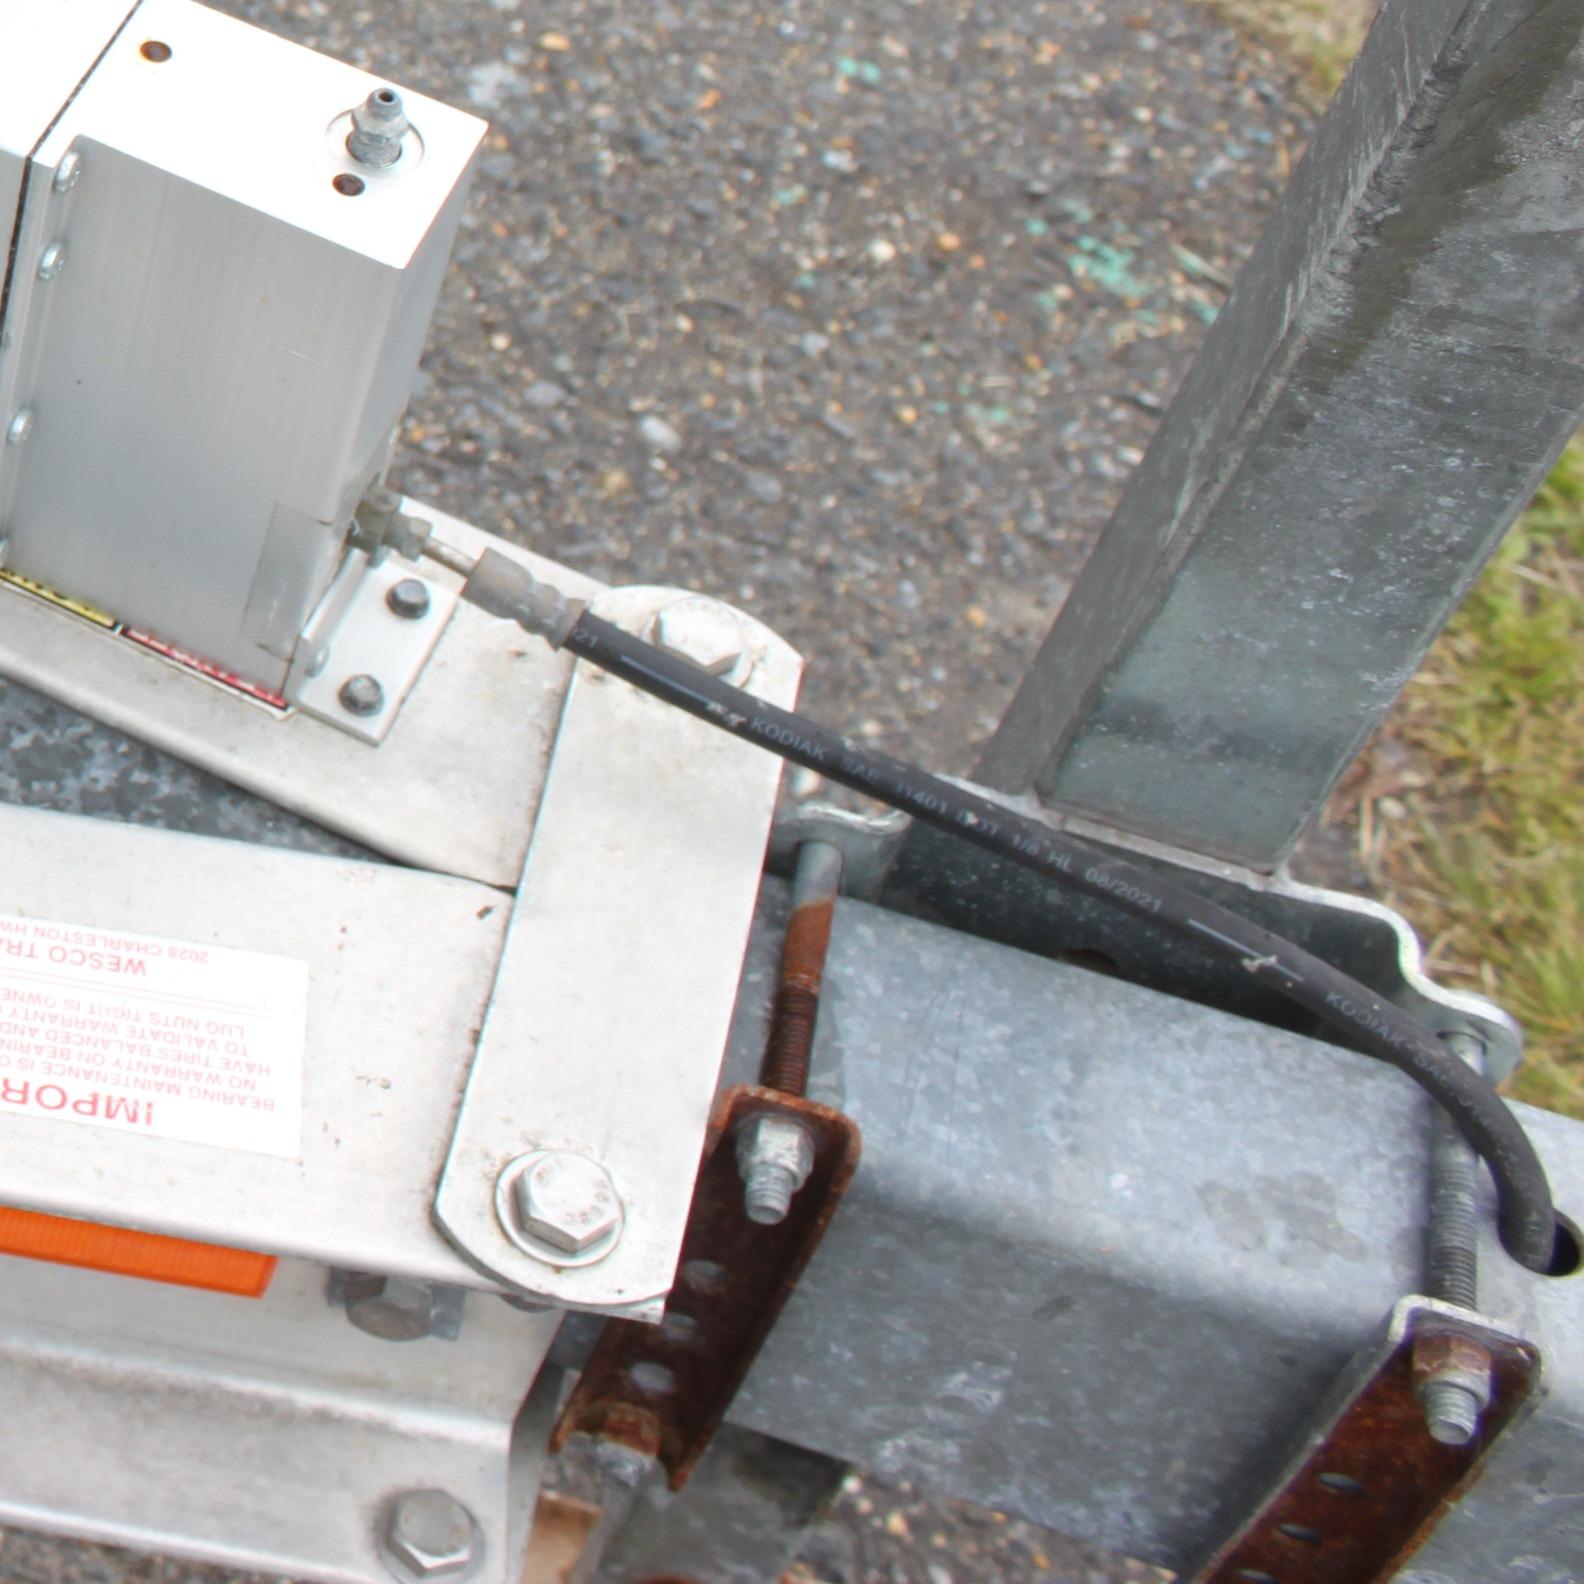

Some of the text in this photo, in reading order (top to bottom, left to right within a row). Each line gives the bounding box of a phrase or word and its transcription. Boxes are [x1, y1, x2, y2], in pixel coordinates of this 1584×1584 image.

[747, 717, 828, 762] KODIAK
[1012, 832, 1041, 857] 1/8
[1046, 850, 1072, 874] HL
[1085, 866, 1163, 913] 08/2021
[32, 924, 162, 957] CHARLESTON
[46, 943, 147, 977] WESCO
[63, 997, 81, 1012] IS
[86, 1000, 142, 1022] TIGHT
[7, 1005, 118, 1035] WARRANTY
[147, 1010, 199, 1031] NUTS
[204, 1020, 245, 1039] LUG
[1324, 990, 1407, 1050] KODIAK
[44, 1027, 151, 1057] BALANCED
[123, 1024, 218, 1052] VALIDATE
[223, 1040, 248, 1057] TO
[16, 1056, 34, 1072] IS
[77, 1050, 105, 1066] ON
[157, 1046, 211, 1067] TIRES
[218, 1056, 271, 1077] HAVE
[39, 1059, 182, 1096] MAINTENANCE
[111, 1055, 221, 1085] WARRANTY
[227, 1074, 256, 1091] NO
[187, 1084, 274, 1112] BEARING
